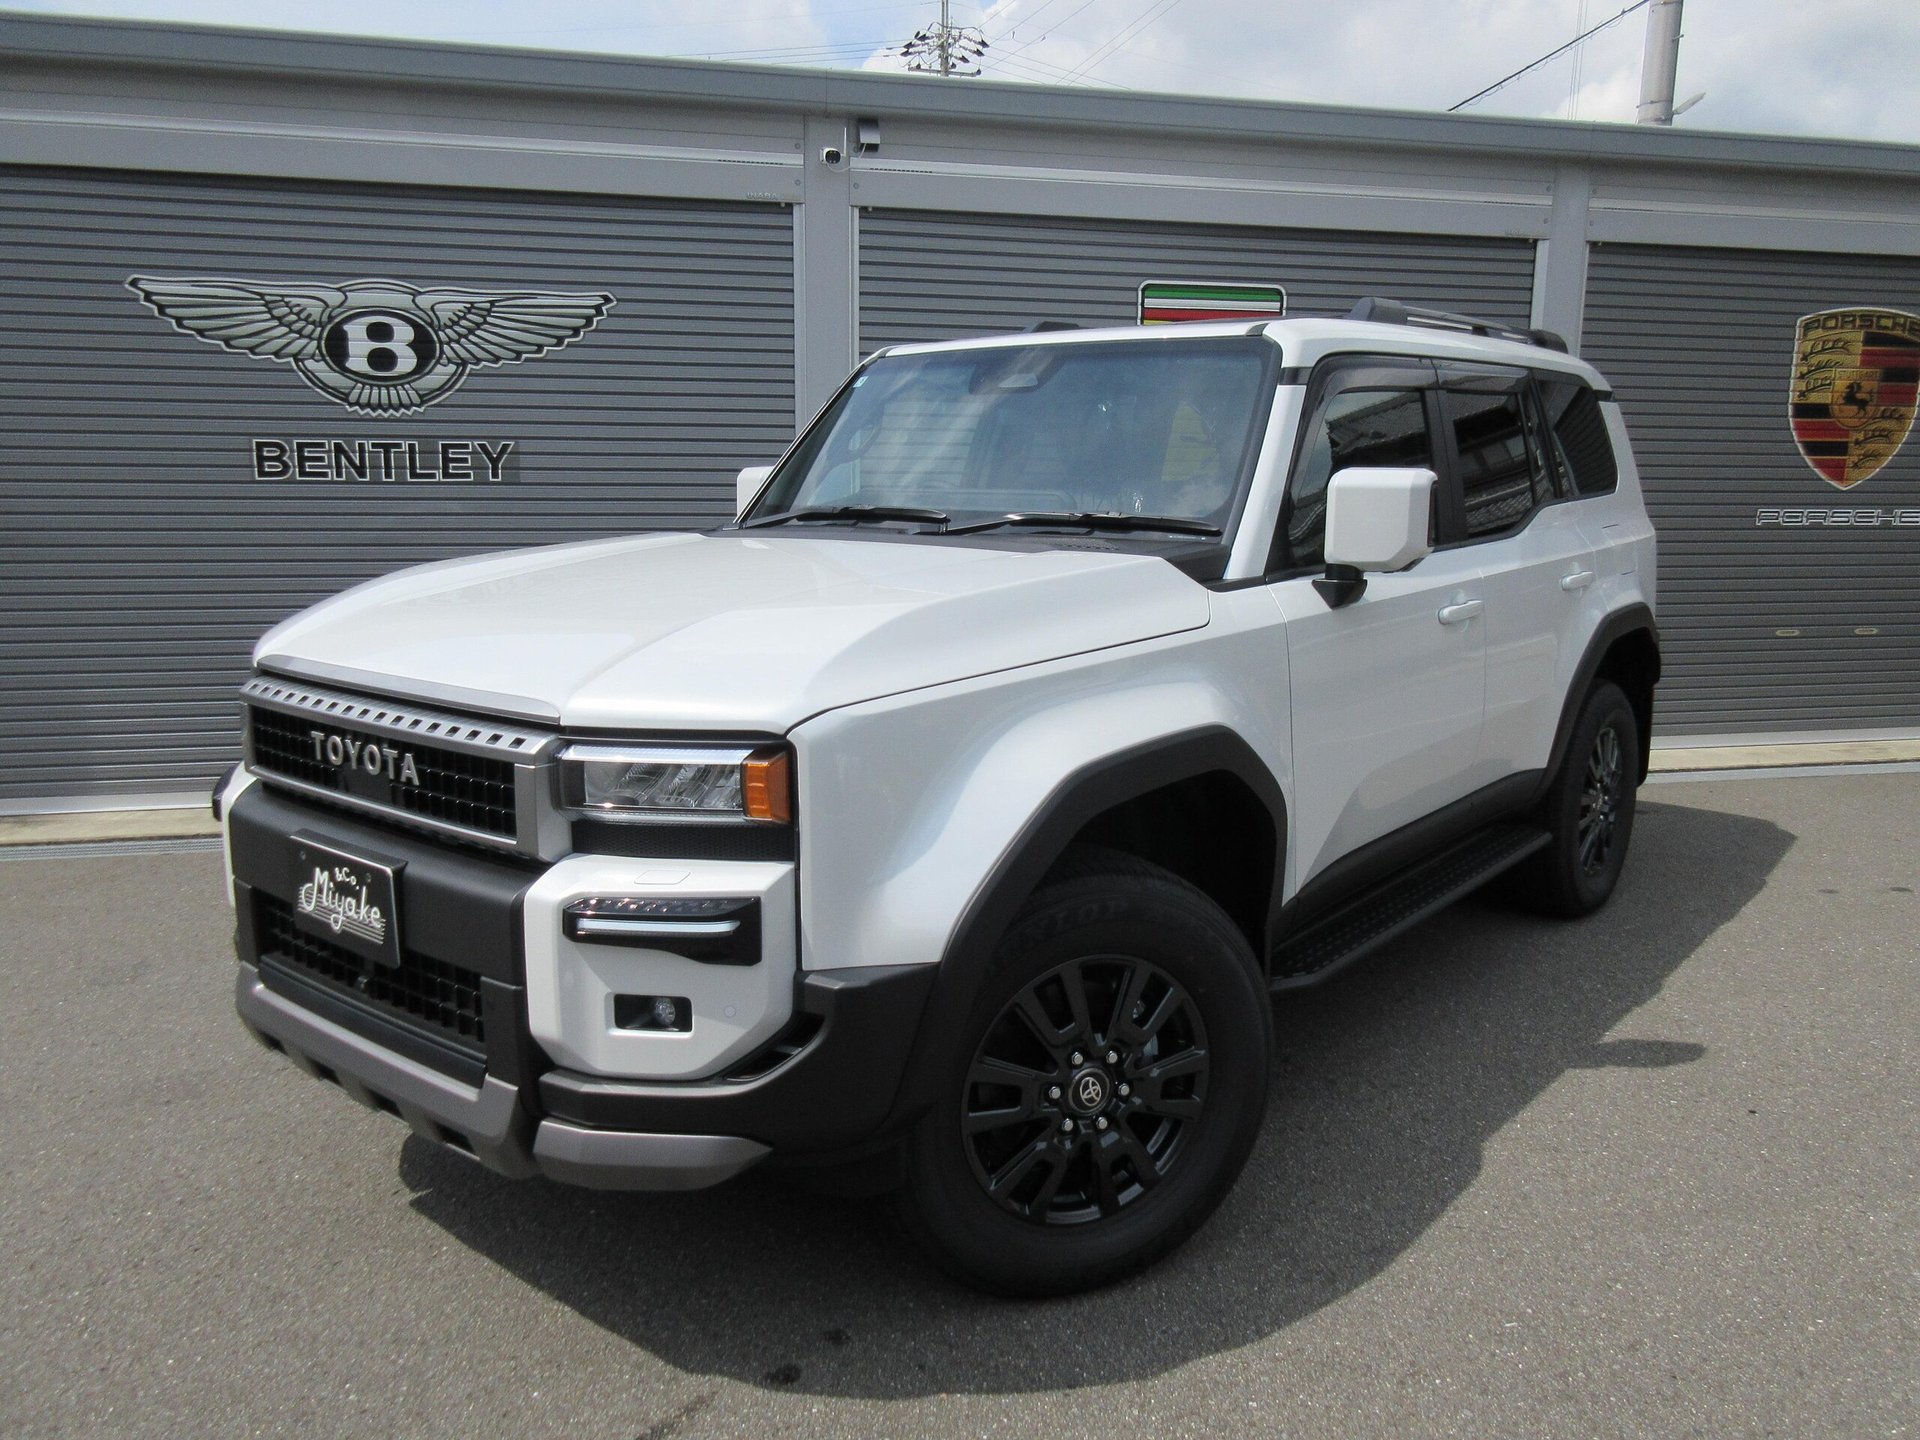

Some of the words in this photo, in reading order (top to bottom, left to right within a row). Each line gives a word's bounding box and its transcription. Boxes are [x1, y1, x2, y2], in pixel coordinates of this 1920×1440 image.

[342, 315, 418, 377] B
[1802, 313, 1920, 338] PORSCHE
[252, 438, 515, 483] BENTLEY
[1755, 508, 1920, 526] PORSCHE
[310, 730, 420, 786] TOYOTA
[301, 866, 382, 932] Miyake
